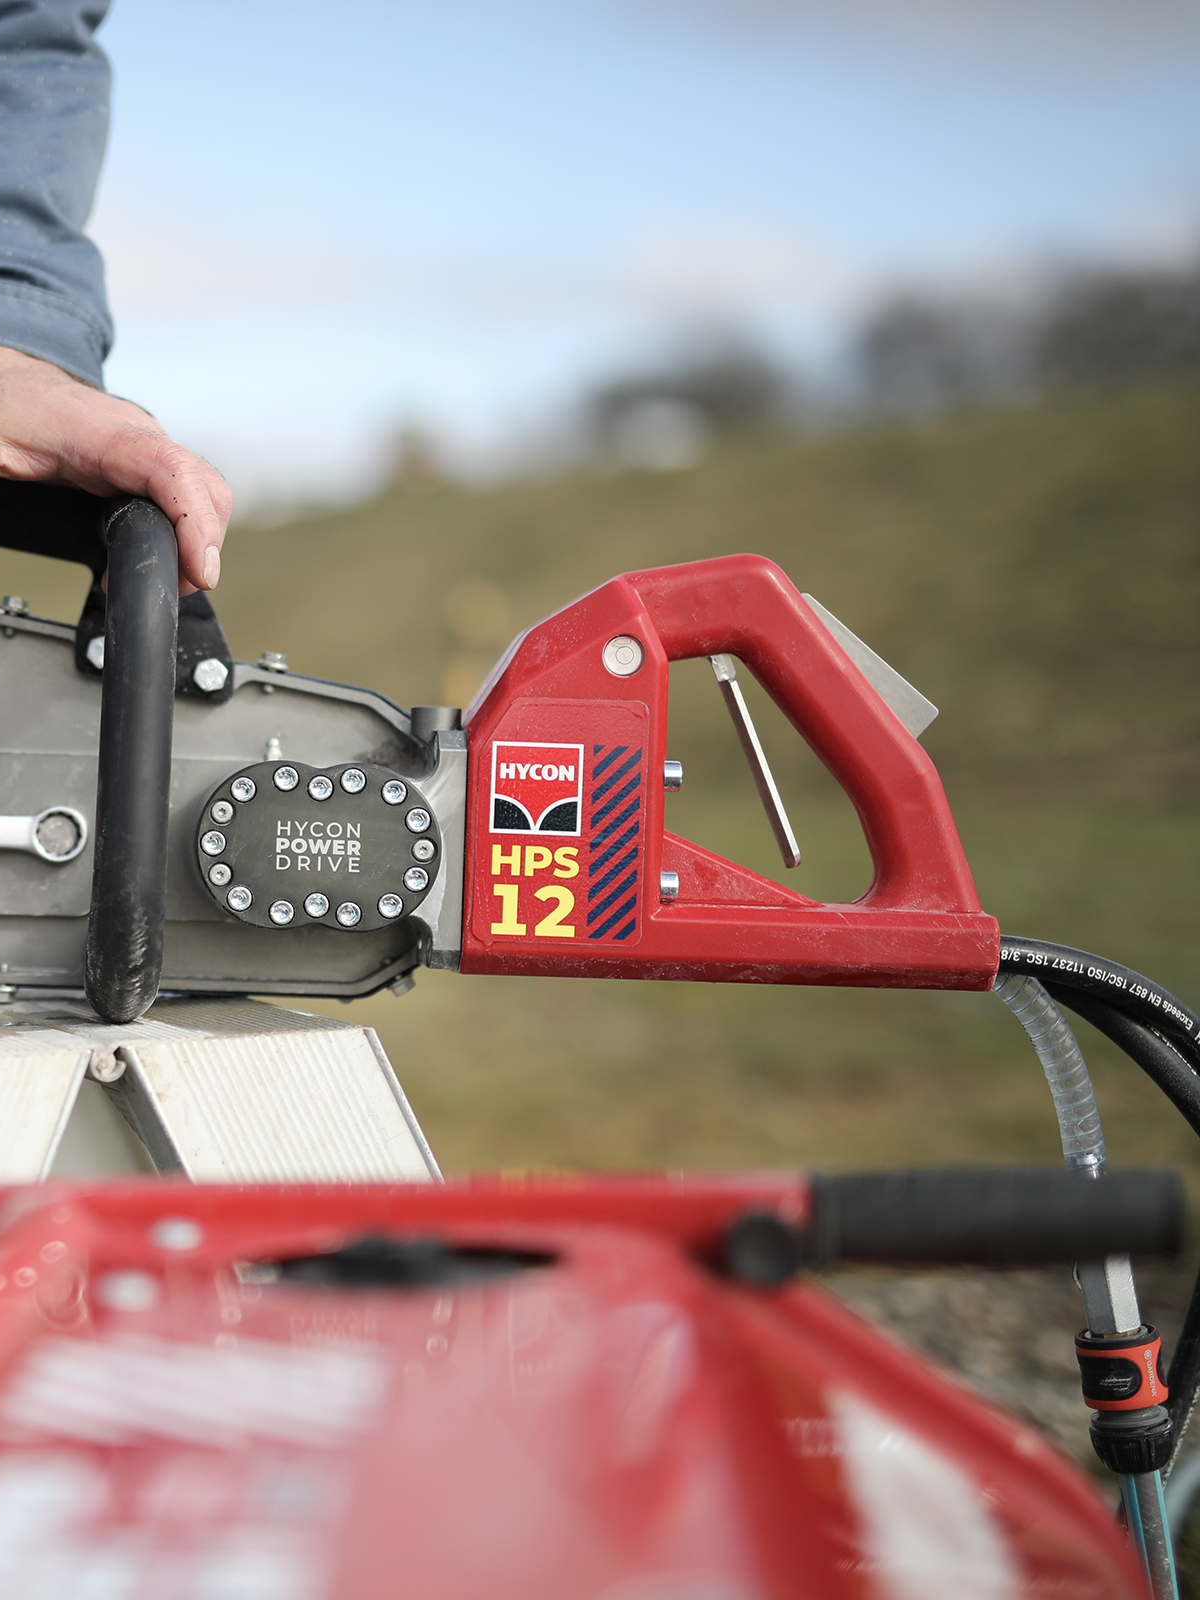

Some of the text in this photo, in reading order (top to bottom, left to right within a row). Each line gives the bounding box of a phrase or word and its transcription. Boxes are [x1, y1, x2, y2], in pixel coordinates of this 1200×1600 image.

[499, 762, 575, 782] HYCON
[276, 820, 361, 839] HYCON
[275, 837, 362, 856] POWER
[275, 854, 361, 873] DRIVE
[490, 843, 581, 879] HPS
[490, 883, 576, 938] 12
[1000, 949, 1194, 1031] Exceeds EN 857 1SC/ISO 11237 1SC 3/8
[1146, 1360, 1157, 1396] GARDENA
